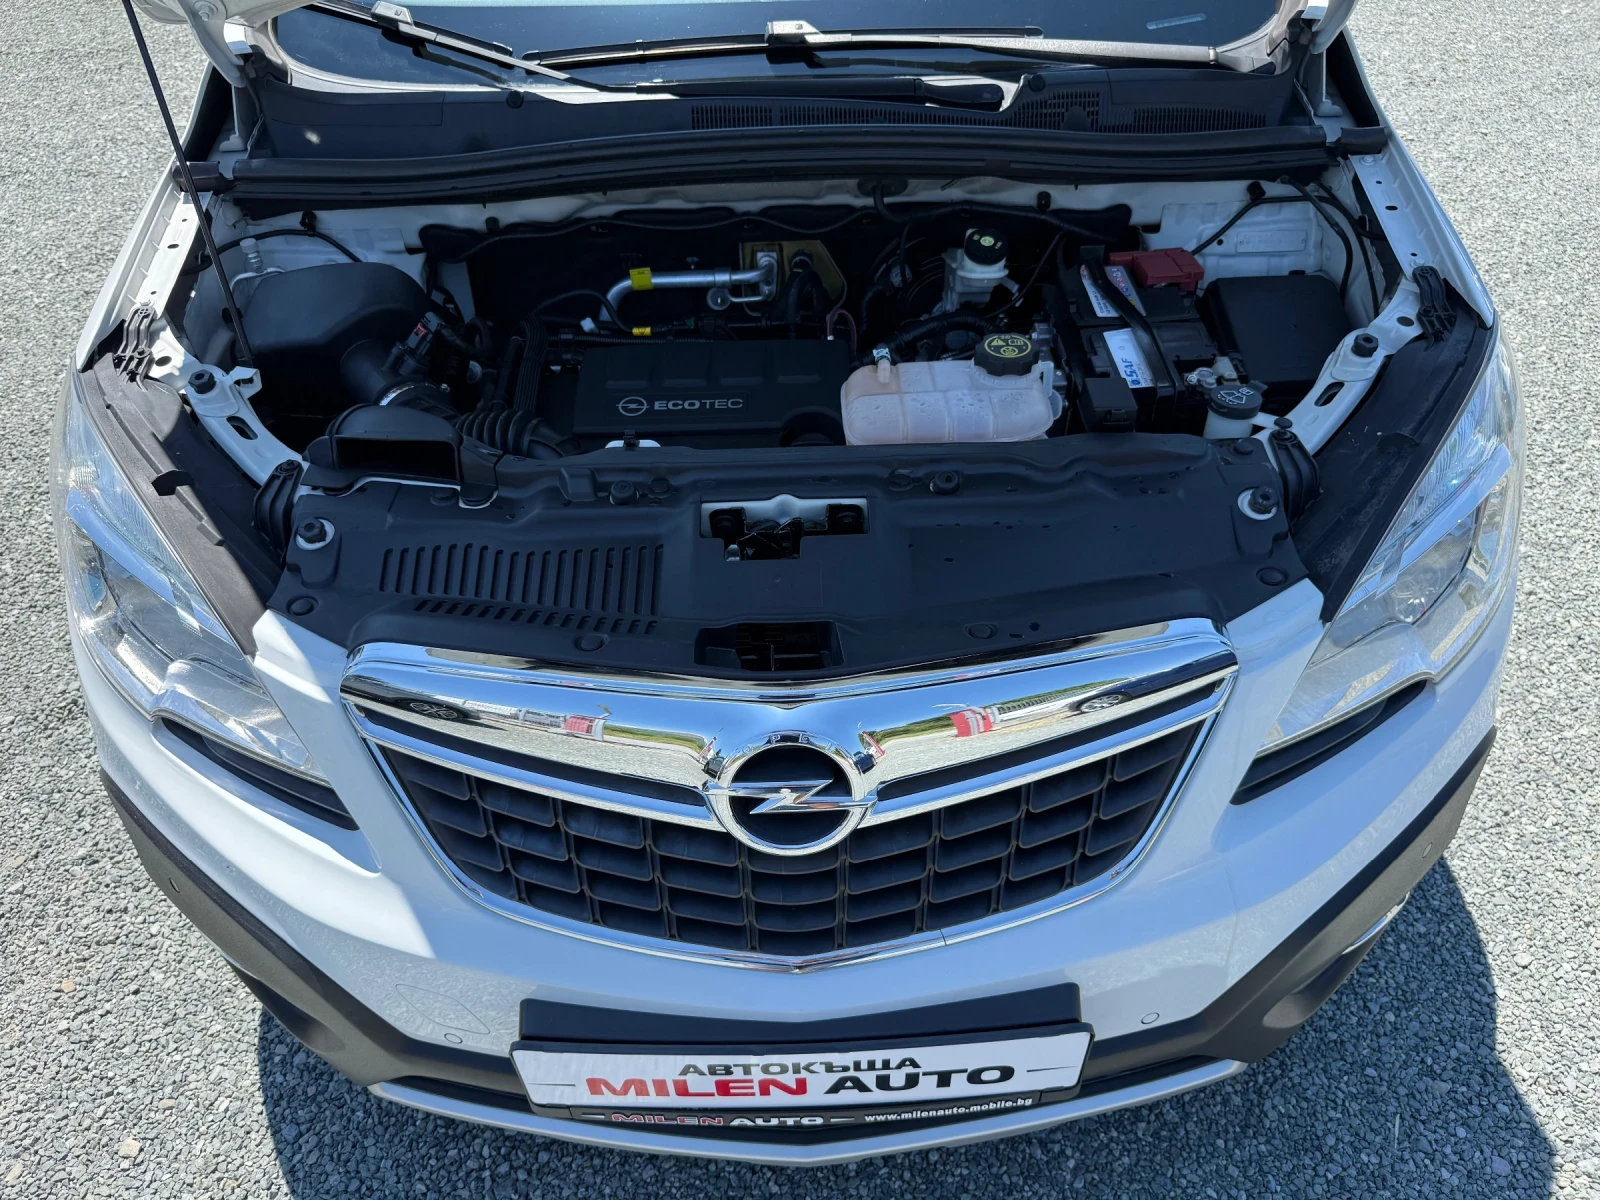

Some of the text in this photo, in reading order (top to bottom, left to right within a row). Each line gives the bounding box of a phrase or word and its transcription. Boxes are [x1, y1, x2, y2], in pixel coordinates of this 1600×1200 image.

[653, 399, 744, 410] ECOTEC
[585, 1065, 1015, 1097] MILEN AUTO
[611, 1098, 1033, 1127] MILEN AUTO www.milenauto.mobile.bg
